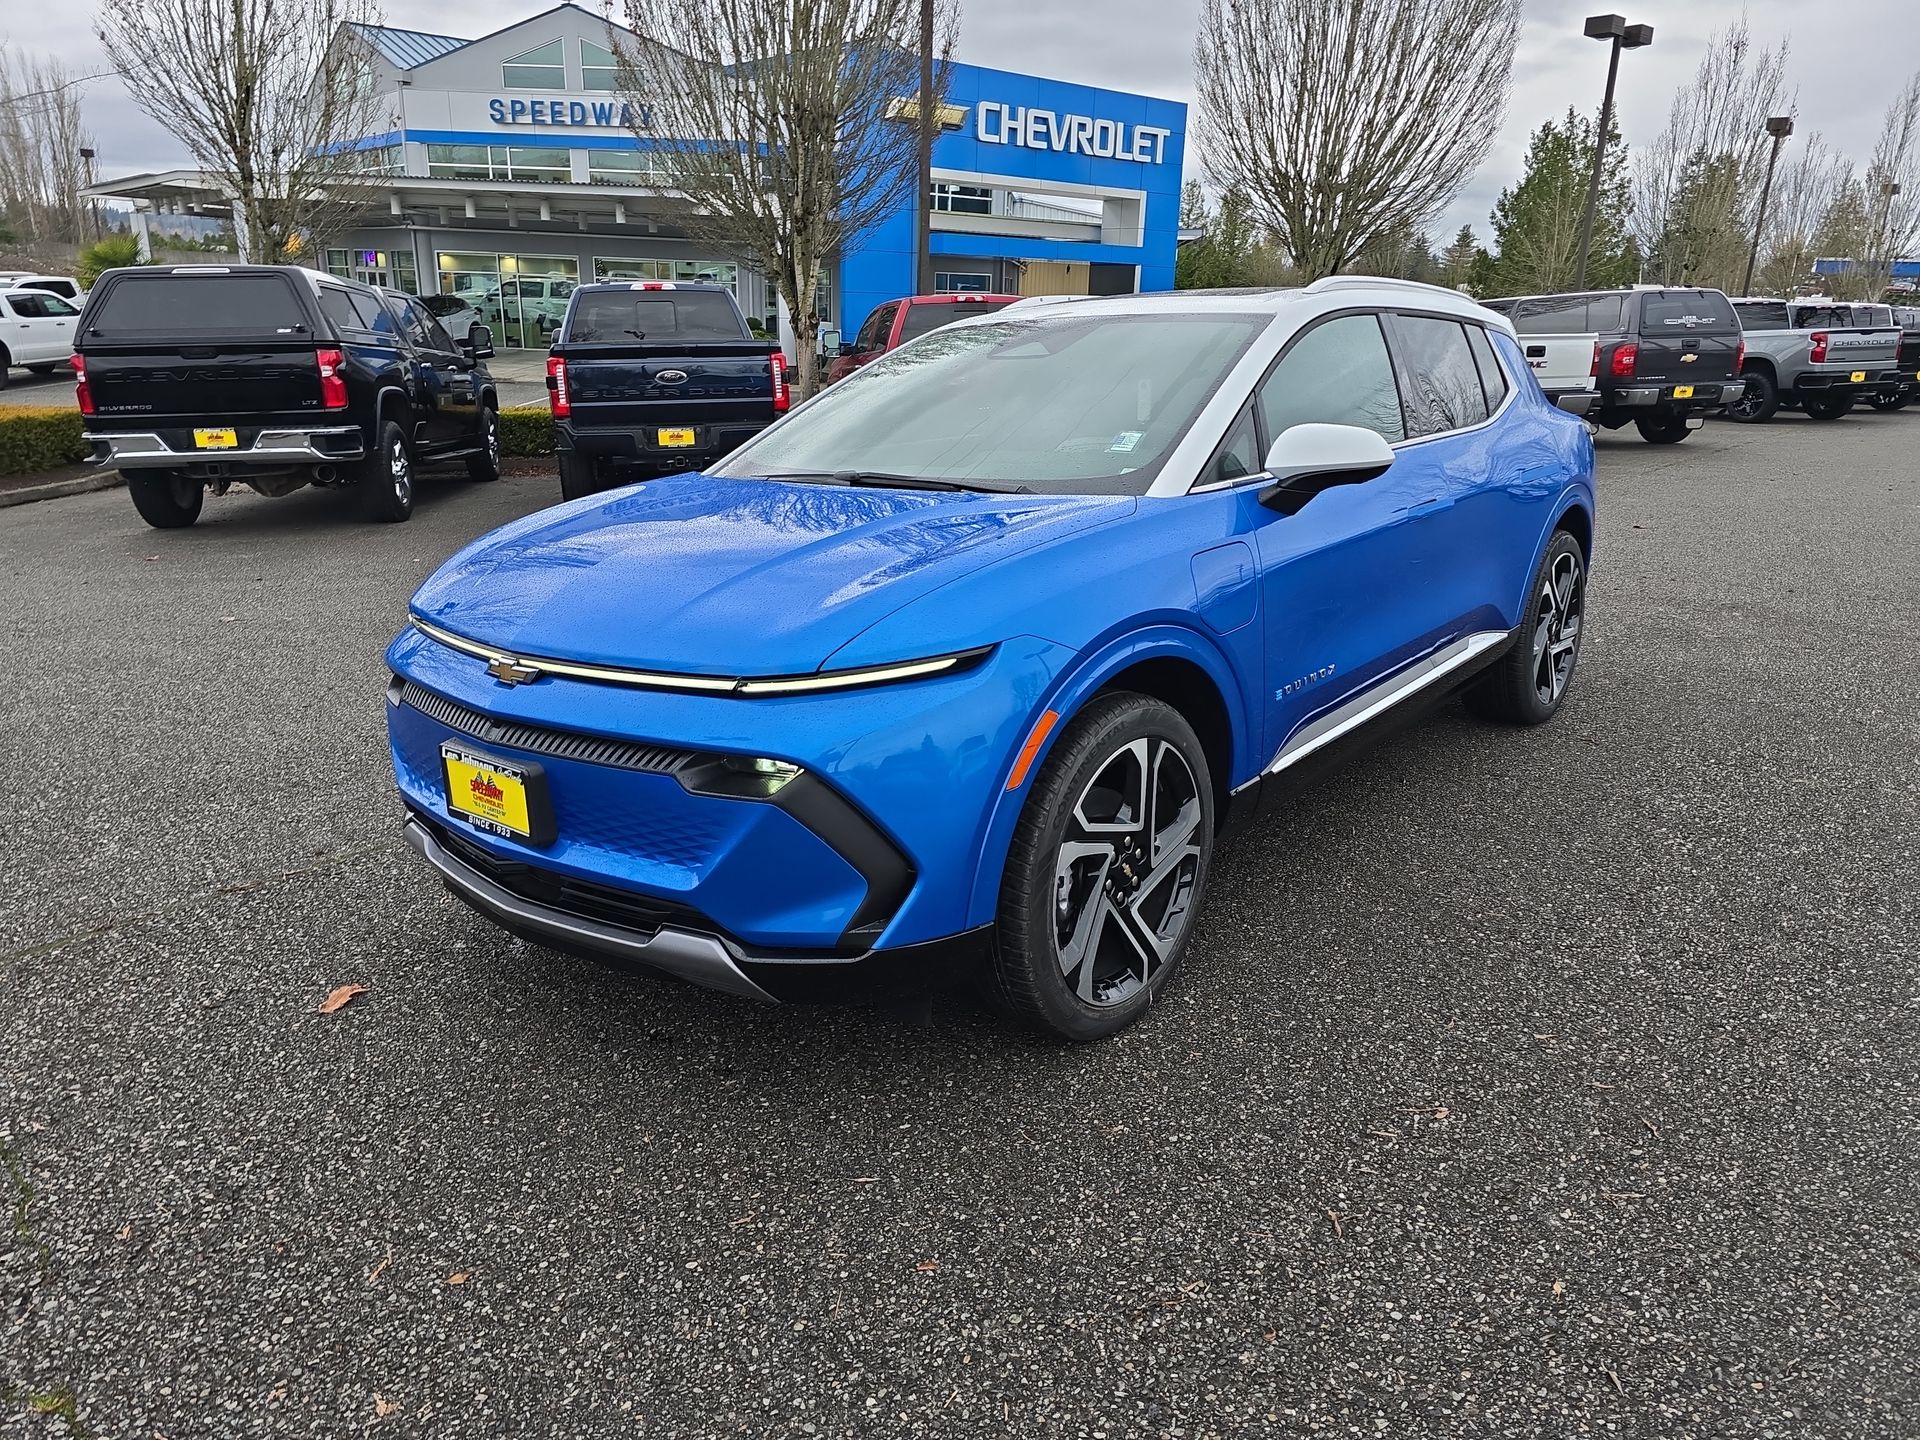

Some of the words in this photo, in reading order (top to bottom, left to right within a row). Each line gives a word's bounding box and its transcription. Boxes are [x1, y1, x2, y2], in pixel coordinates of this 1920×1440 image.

[489, 98, 653, 128] SPEEDWAY
[976, 100, 1171, 164] CHEVROLET
[1833, 339, 1895, 347] CHEVROLET
[105, 368, 303, 383] CHEVROLET
[581, 388, 681, 399] SUPER
[689, 386, 761, 396] DUTY
[98, 404, 153, 412] SILVERADO
[1275, 663, 1336, 701] EQUINOX
[468, 815, 490, 830] SINCE
[492, 824, 511, 838] 1933
